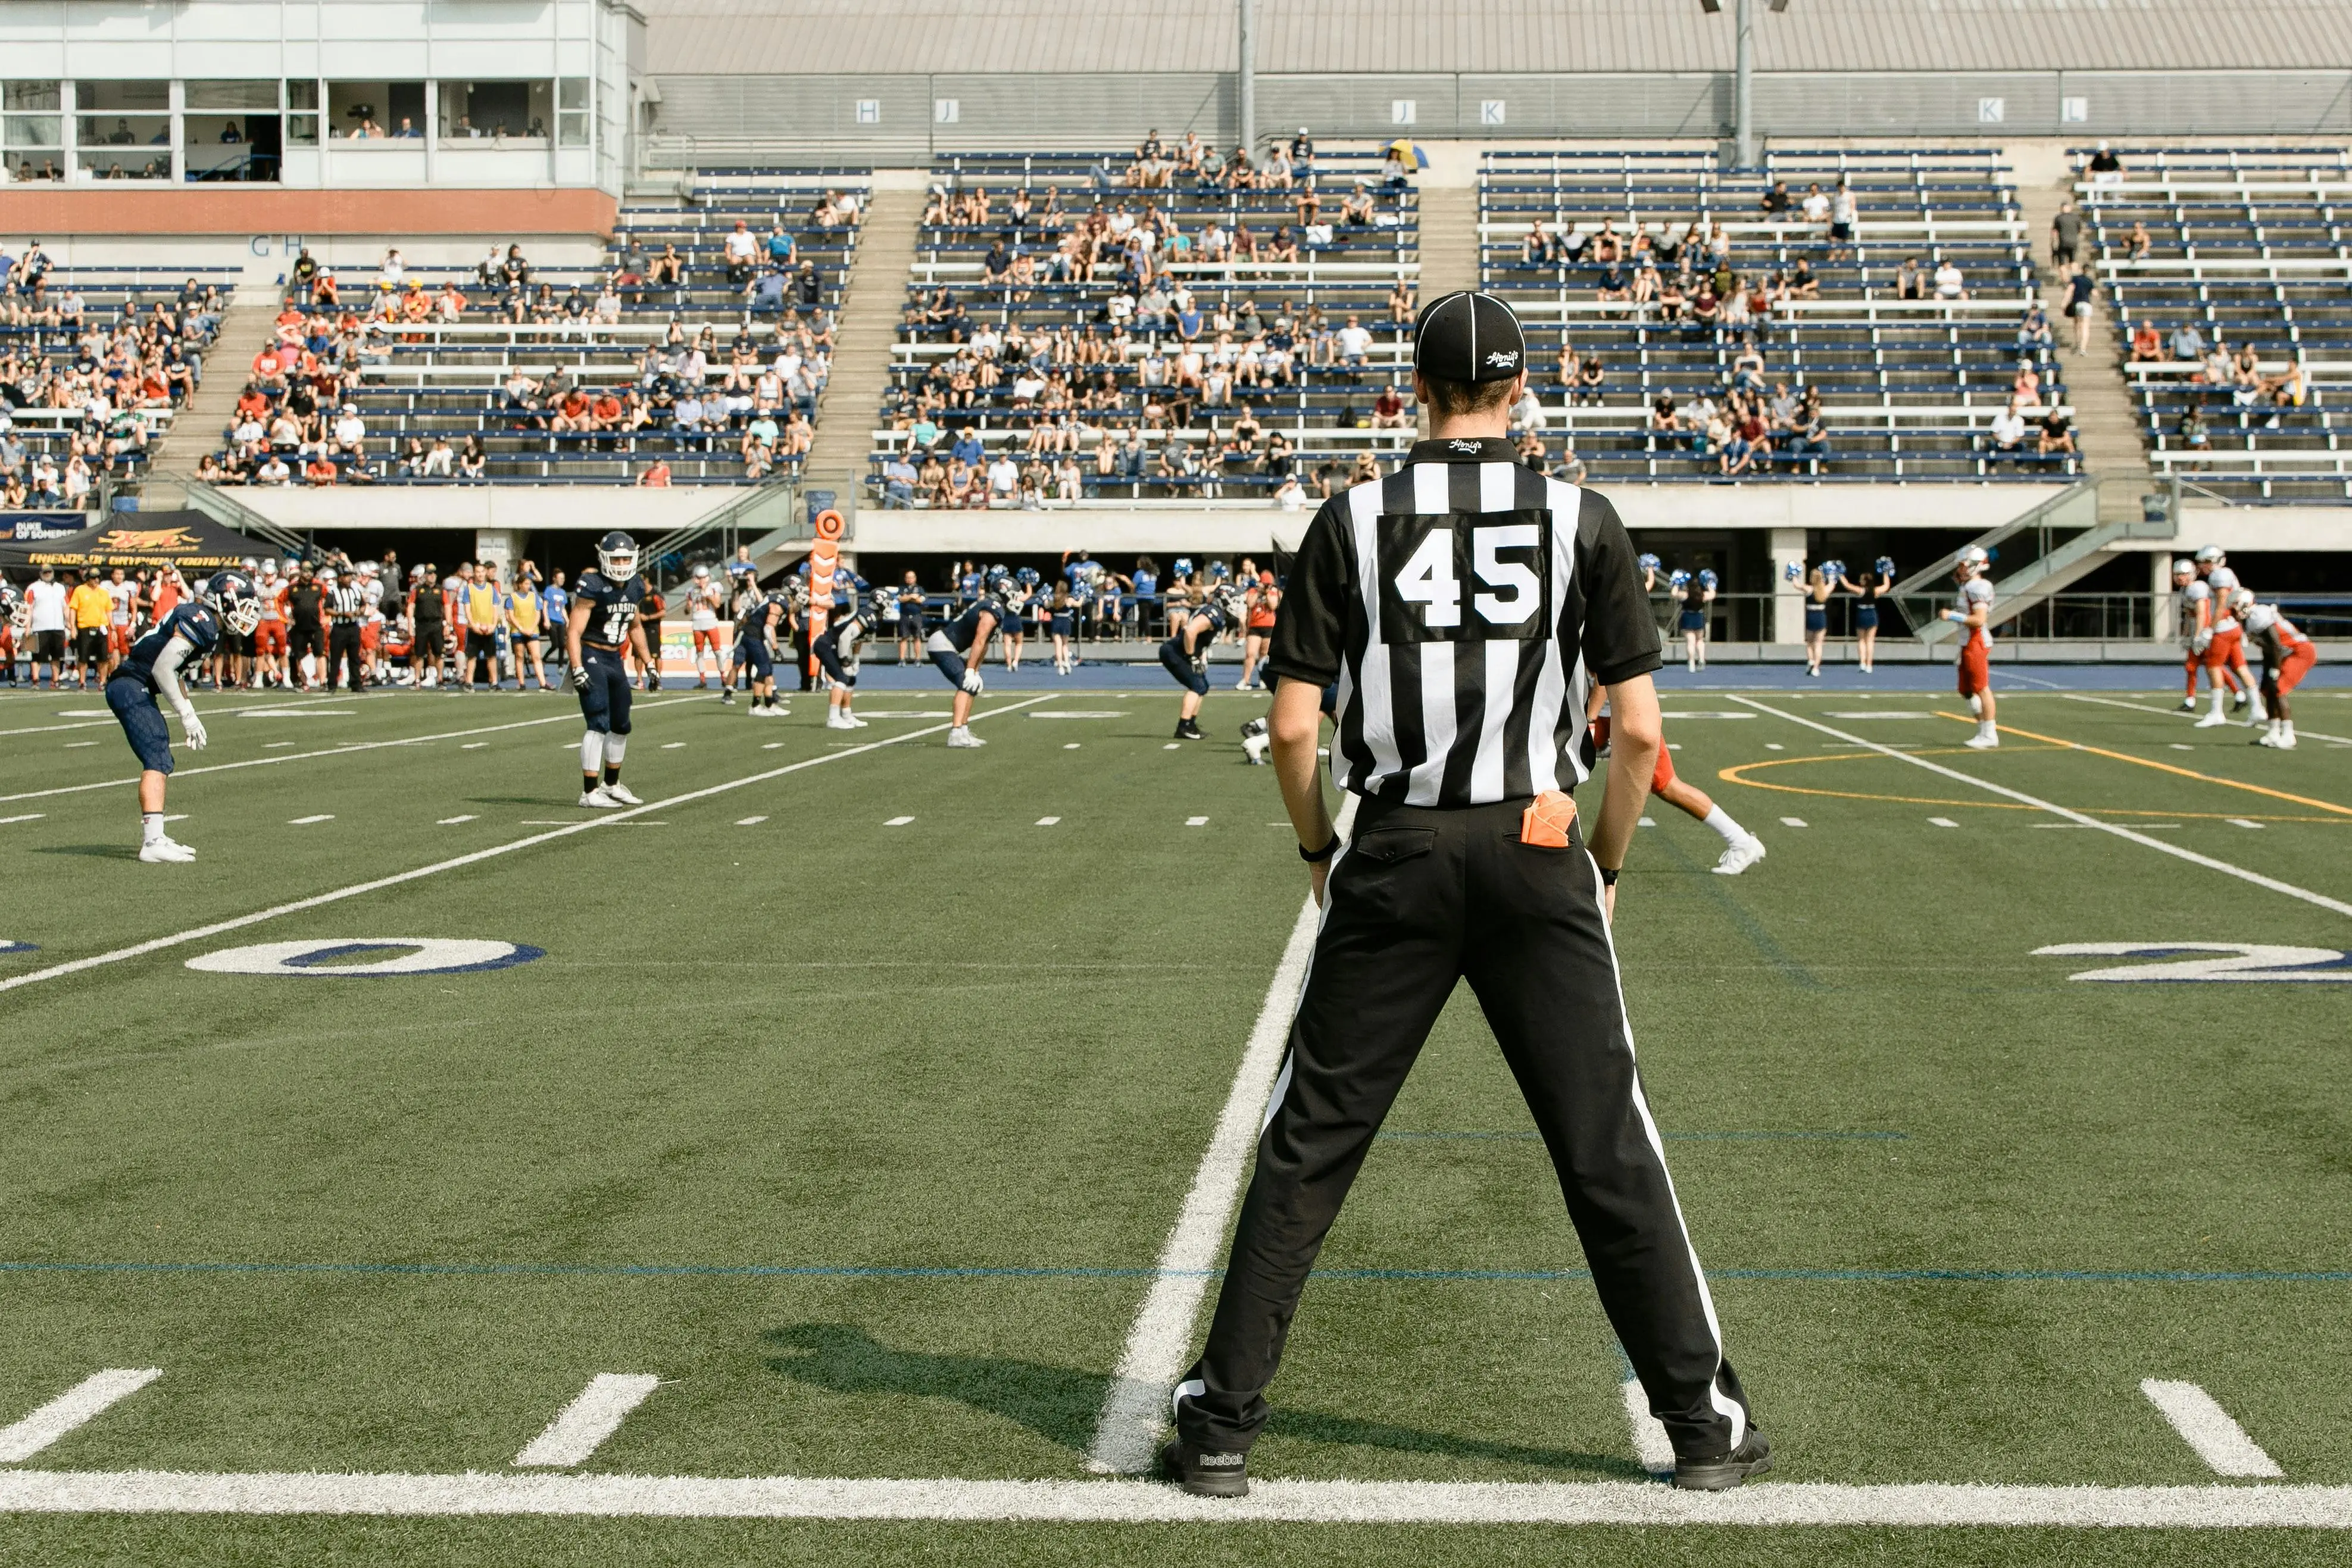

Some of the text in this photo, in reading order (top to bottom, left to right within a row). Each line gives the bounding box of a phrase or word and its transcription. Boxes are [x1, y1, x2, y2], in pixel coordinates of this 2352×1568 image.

[860, 101, 876, 121] H
[944, 101, 951, 121] J
[1401, 102, 1407, 123] J
[1485, 102, 1501, 124] K
[1983, 101, 1999, 121] K
[2068, 101, 2082, 120] L
[252, 235, 269, 257] G
[285, 235, 301, 256] H
[29, 552, 86, 565] FRIENDS
[1394, 524, 1541, 627] 45
[1200, 1453, 1244, 1466] Reebok
